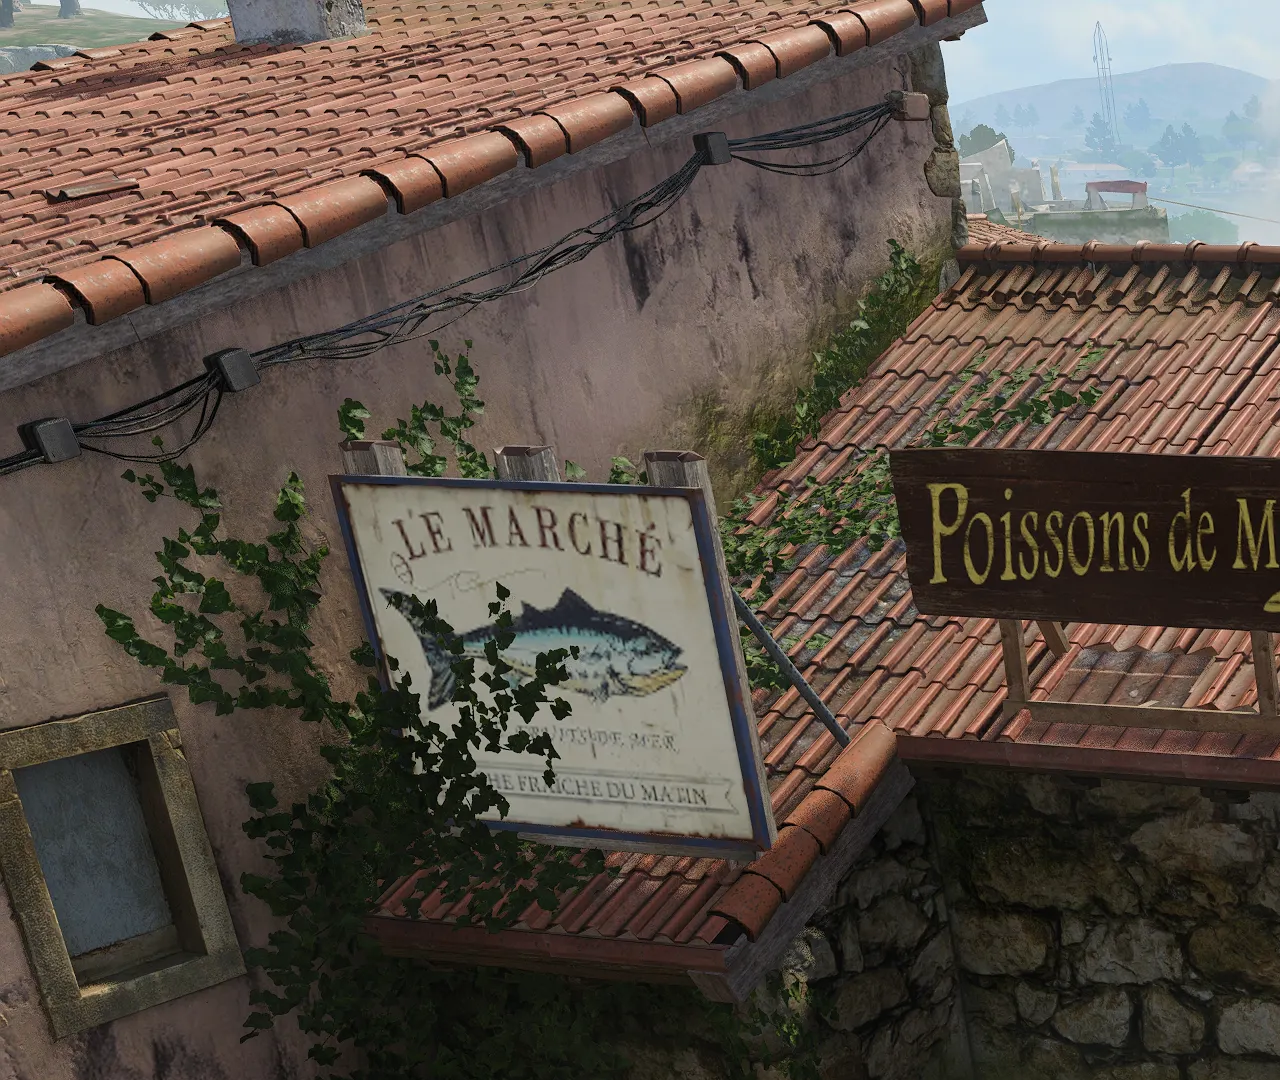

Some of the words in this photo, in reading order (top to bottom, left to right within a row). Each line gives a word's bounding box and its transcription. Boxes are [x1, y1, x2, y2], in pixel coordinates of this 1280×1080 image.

[391, 510, 454, 561] LE
[463, 505, 663, 578] MARCHÉ
[925, 482, 1151, 586] Poissons
[1168, 487, 1218, 573] de
[606, 781, 636, 799] DU
[640, 784, 708, 806] MATIN
